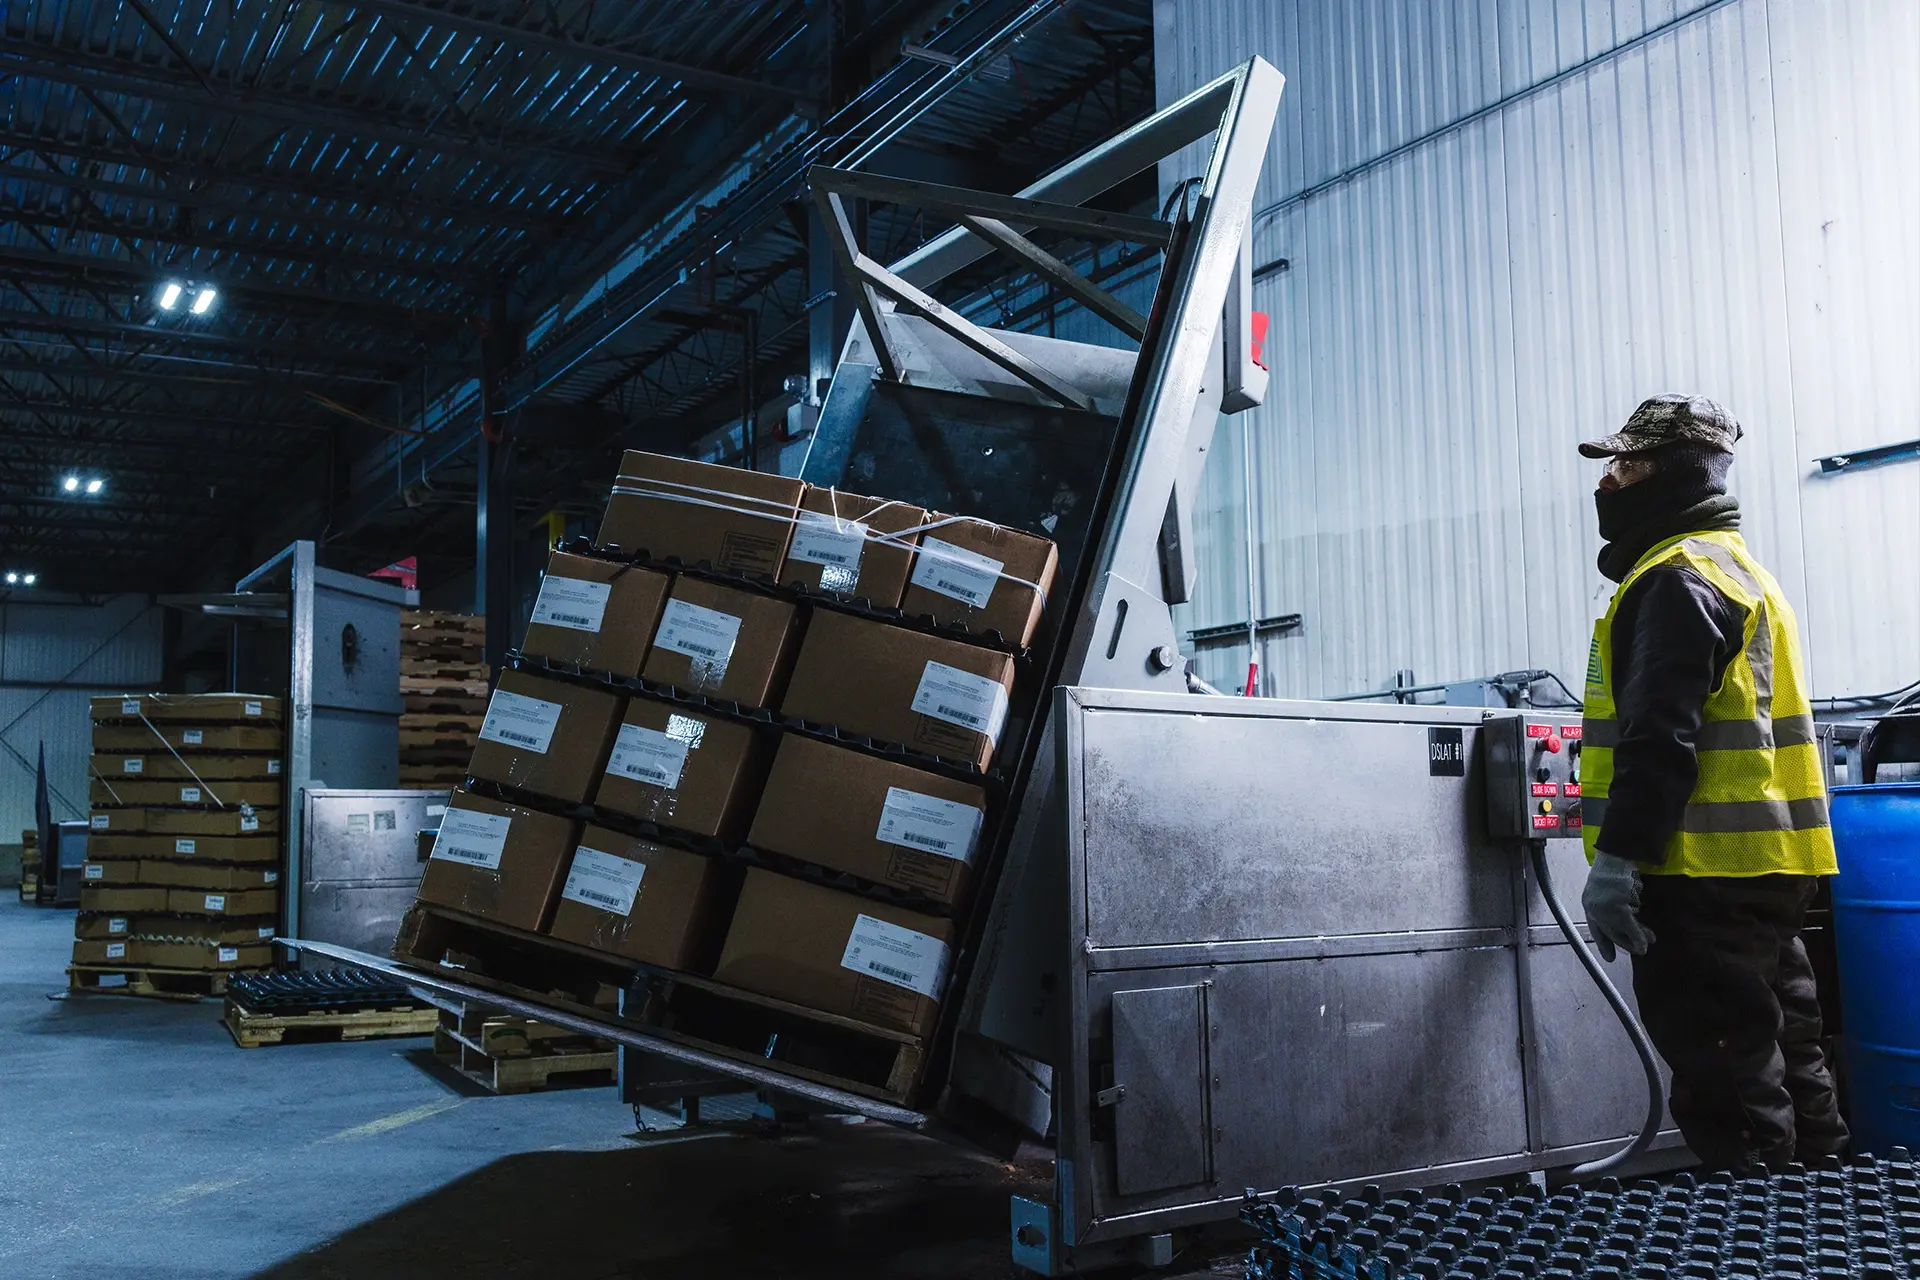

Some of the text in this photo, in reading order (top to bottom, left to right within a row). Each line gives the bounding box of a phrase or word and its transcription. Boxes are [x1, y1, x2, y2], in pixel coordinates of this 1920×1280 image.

[1538, 727, 1550, 736] STOP
[1431, 743, 1452, 761] DSLAT
[1533, 786, 1557, 794] SLIDE DOWN
[1565, 786, 1579, 794] SLIDE
